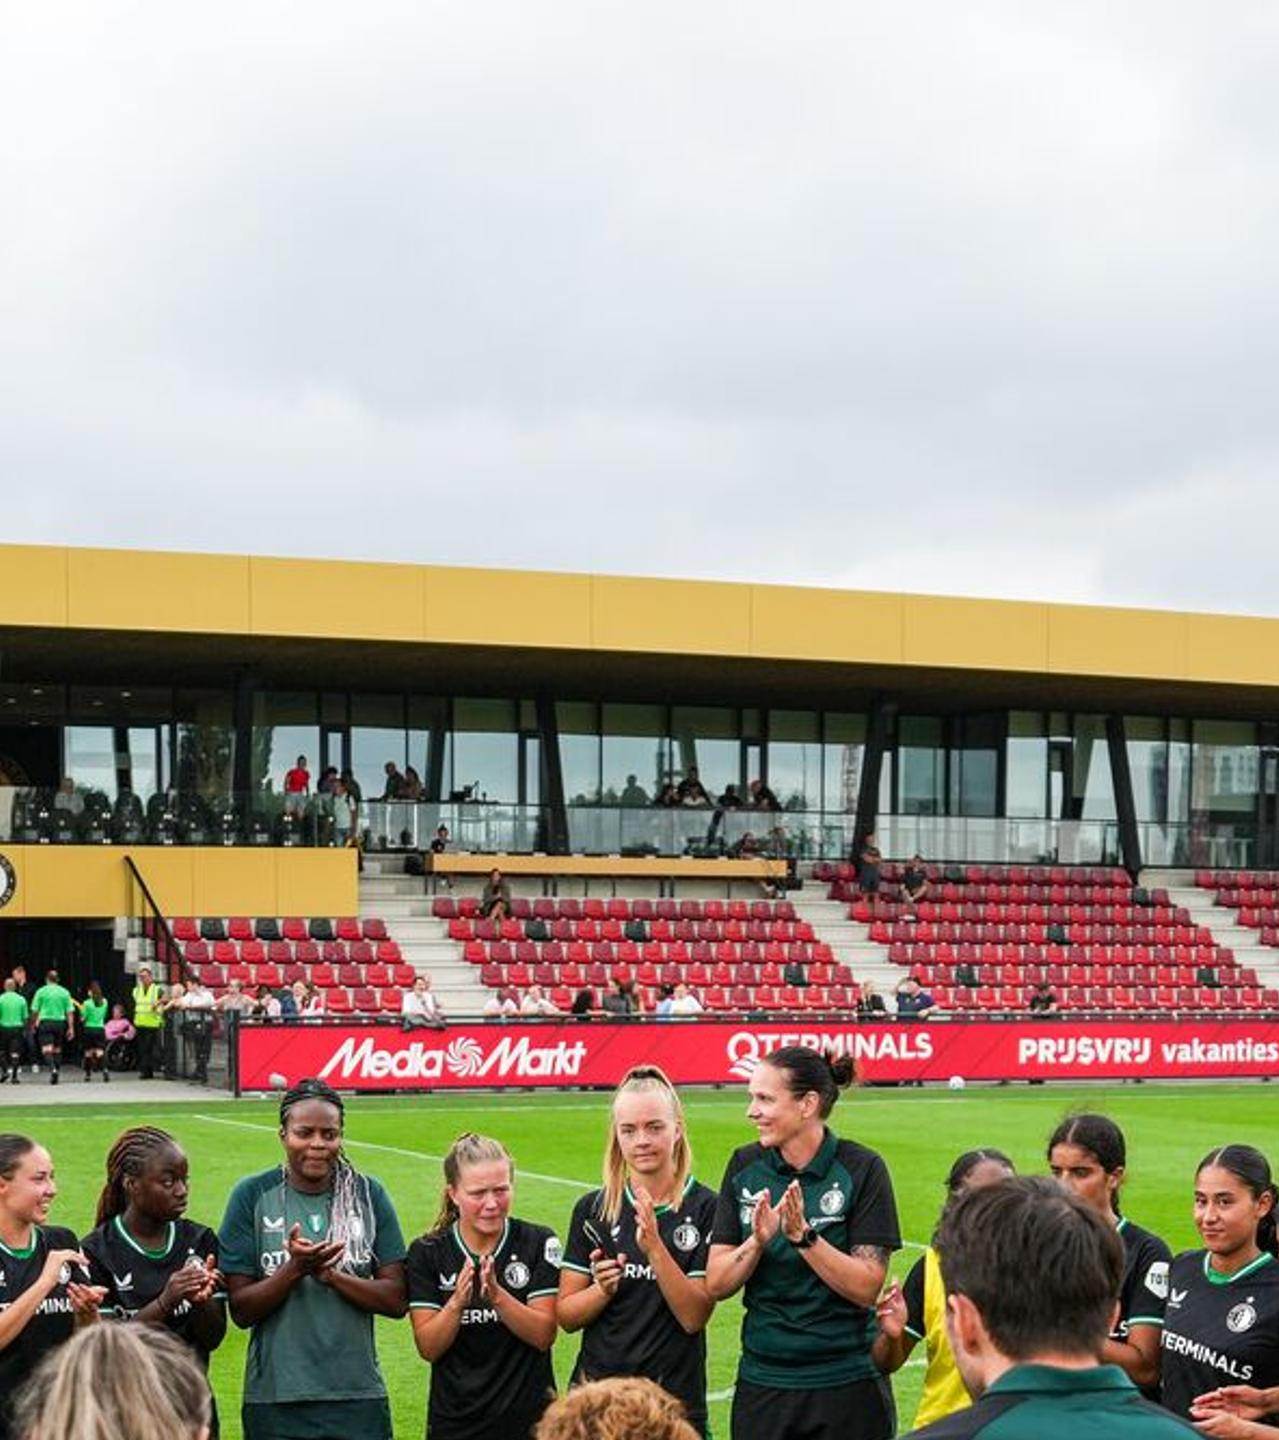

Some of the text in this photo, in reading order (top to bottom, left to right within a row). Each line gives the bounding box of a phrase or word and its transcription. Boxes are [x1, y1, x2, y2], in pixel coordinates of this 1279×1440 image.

[317, 1036, 588, 1078] Media Markt
[1161, 1038, 1279, 1064] vakanties
